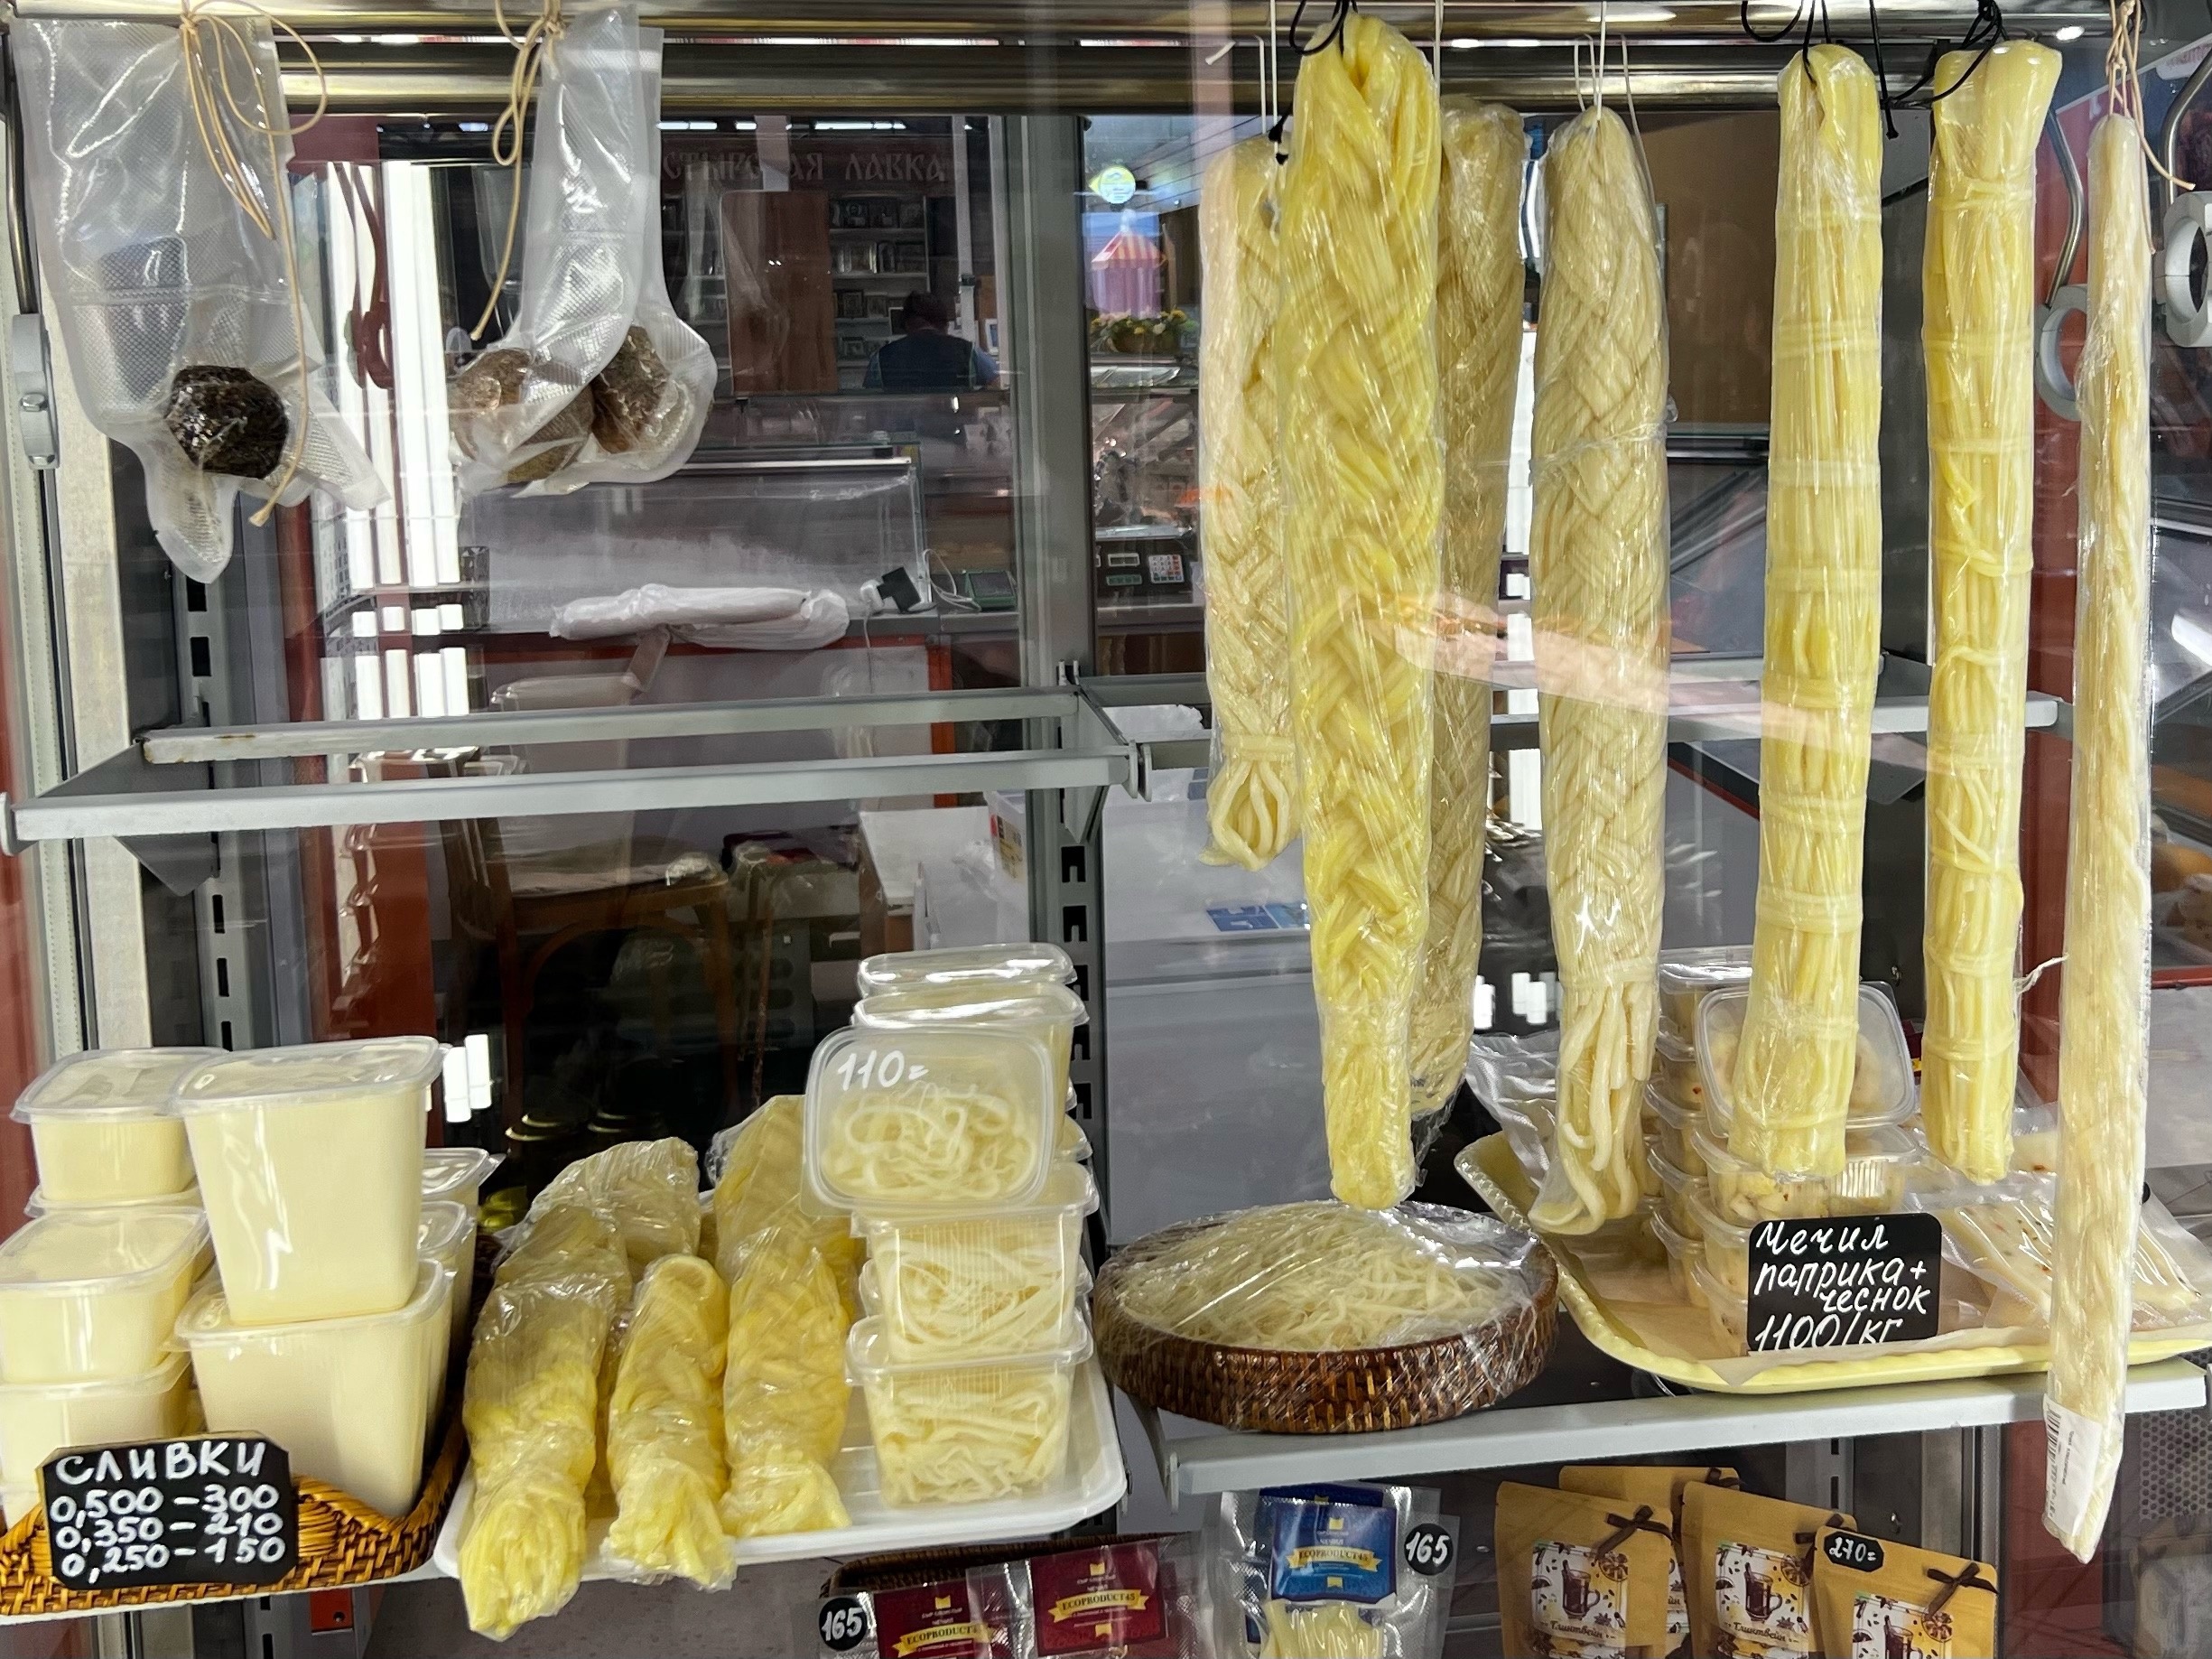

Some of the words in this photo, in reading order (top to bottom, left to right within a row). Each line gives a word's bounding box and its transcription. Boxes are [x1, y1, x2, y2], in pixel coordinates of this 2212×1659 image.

[844, 151, 946, 182] ЛАВКА
[1819, 1285, 1931, 1314] чеснок
[55, 1440, 266, 1485] СЛИВКИ
[1405, 1531, 1450, 1567] 165
[821, 1607, 863, 1642] 165
